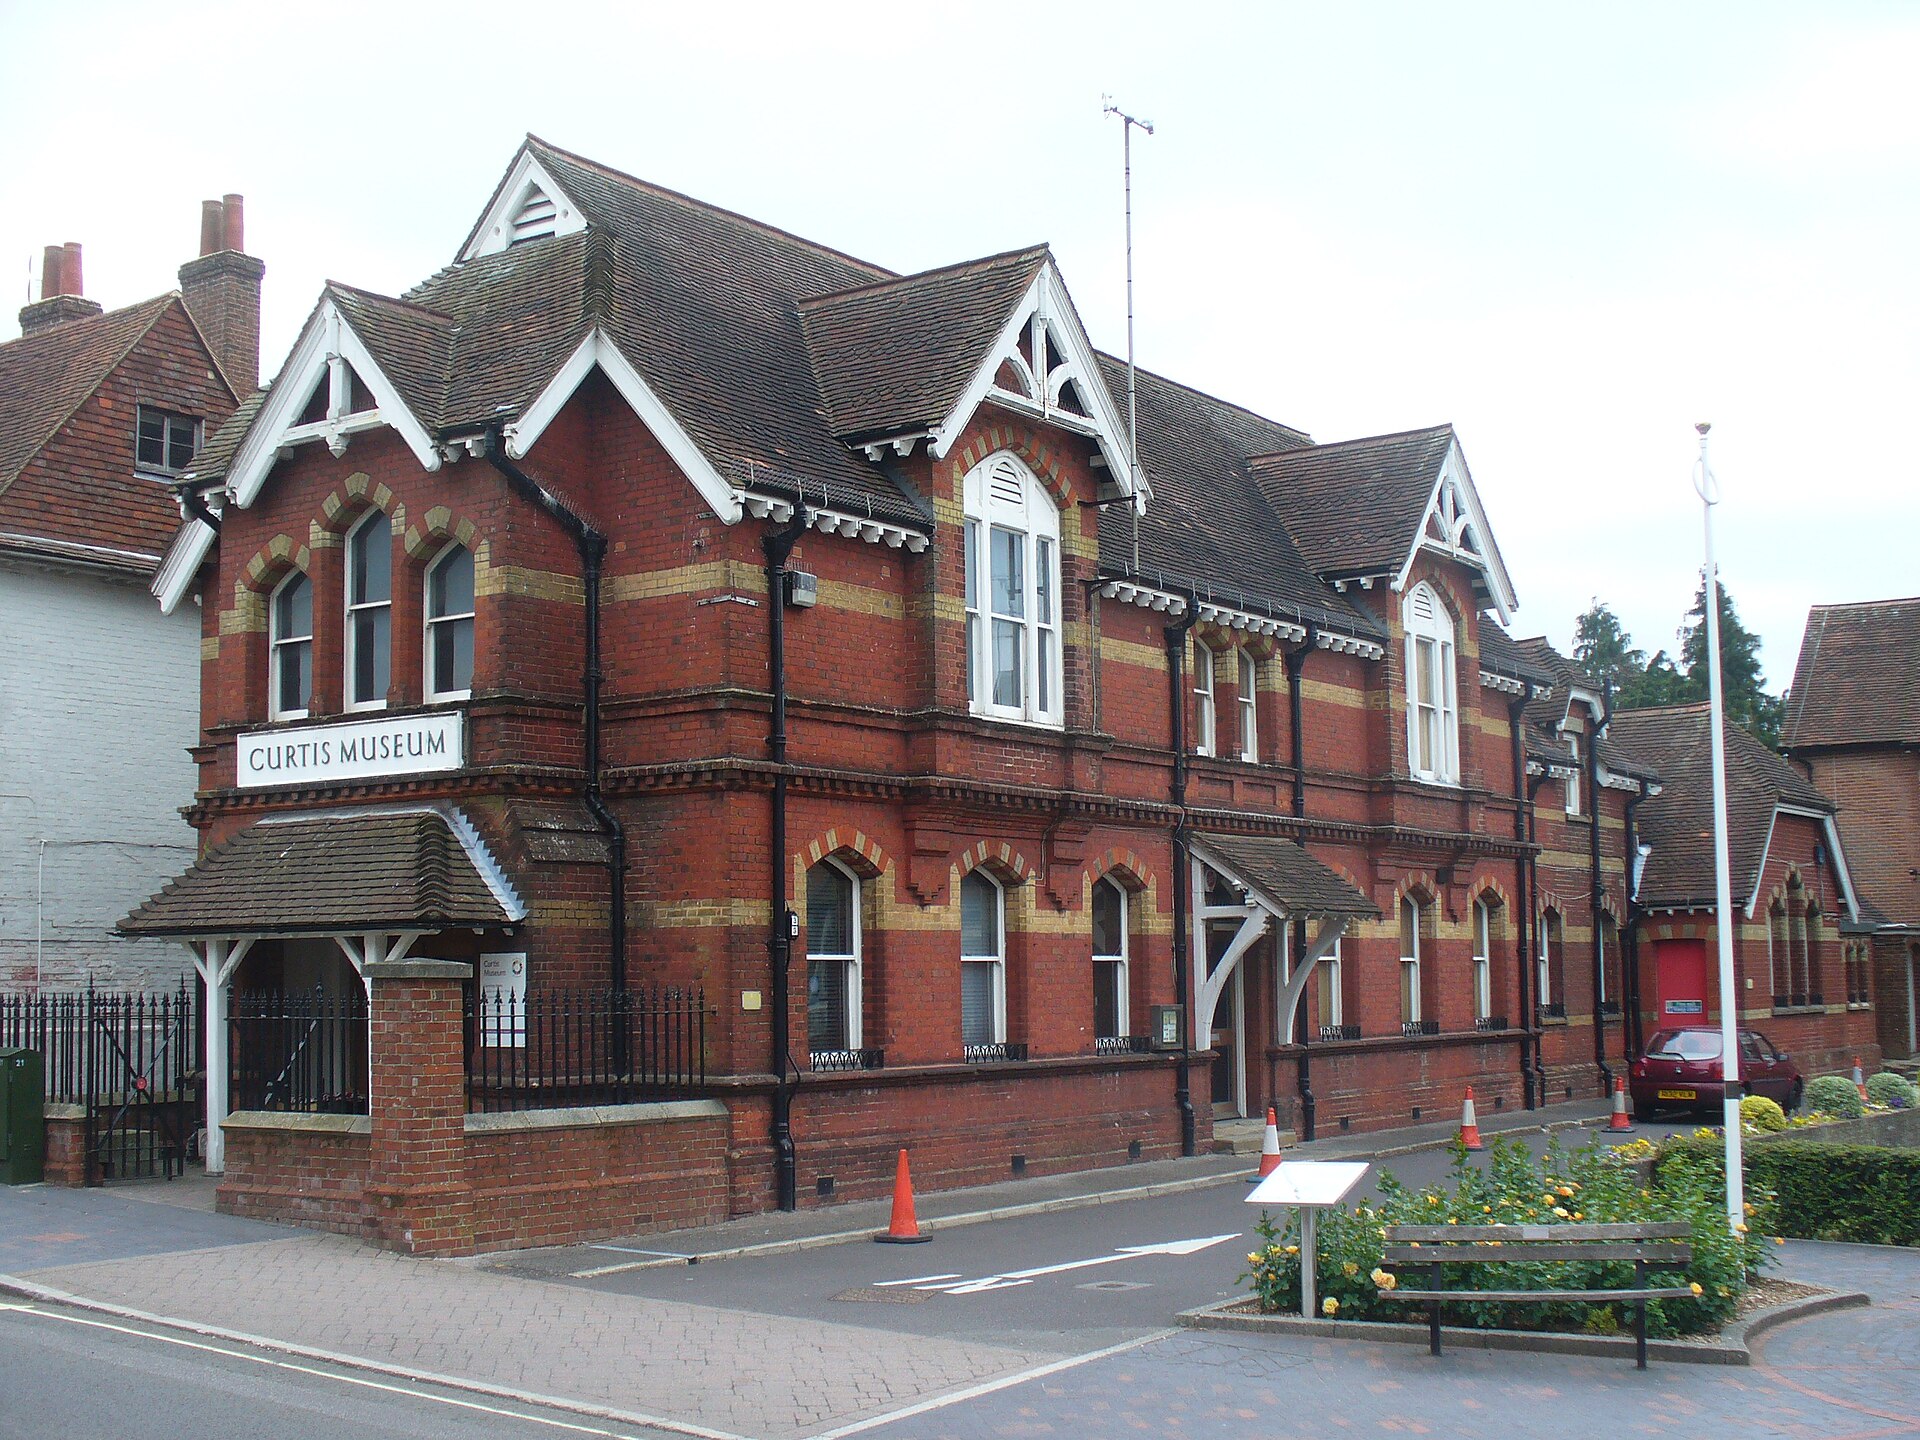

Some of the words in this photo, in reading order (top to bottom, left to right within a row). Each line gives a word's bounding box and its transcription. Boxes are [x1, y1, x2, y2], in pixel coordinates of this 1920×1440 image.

[249, 741, 331, 772] CURTIS
[340, 729, 446, 763] MUSEUM
[15, 1059, 24, 1067] 21
